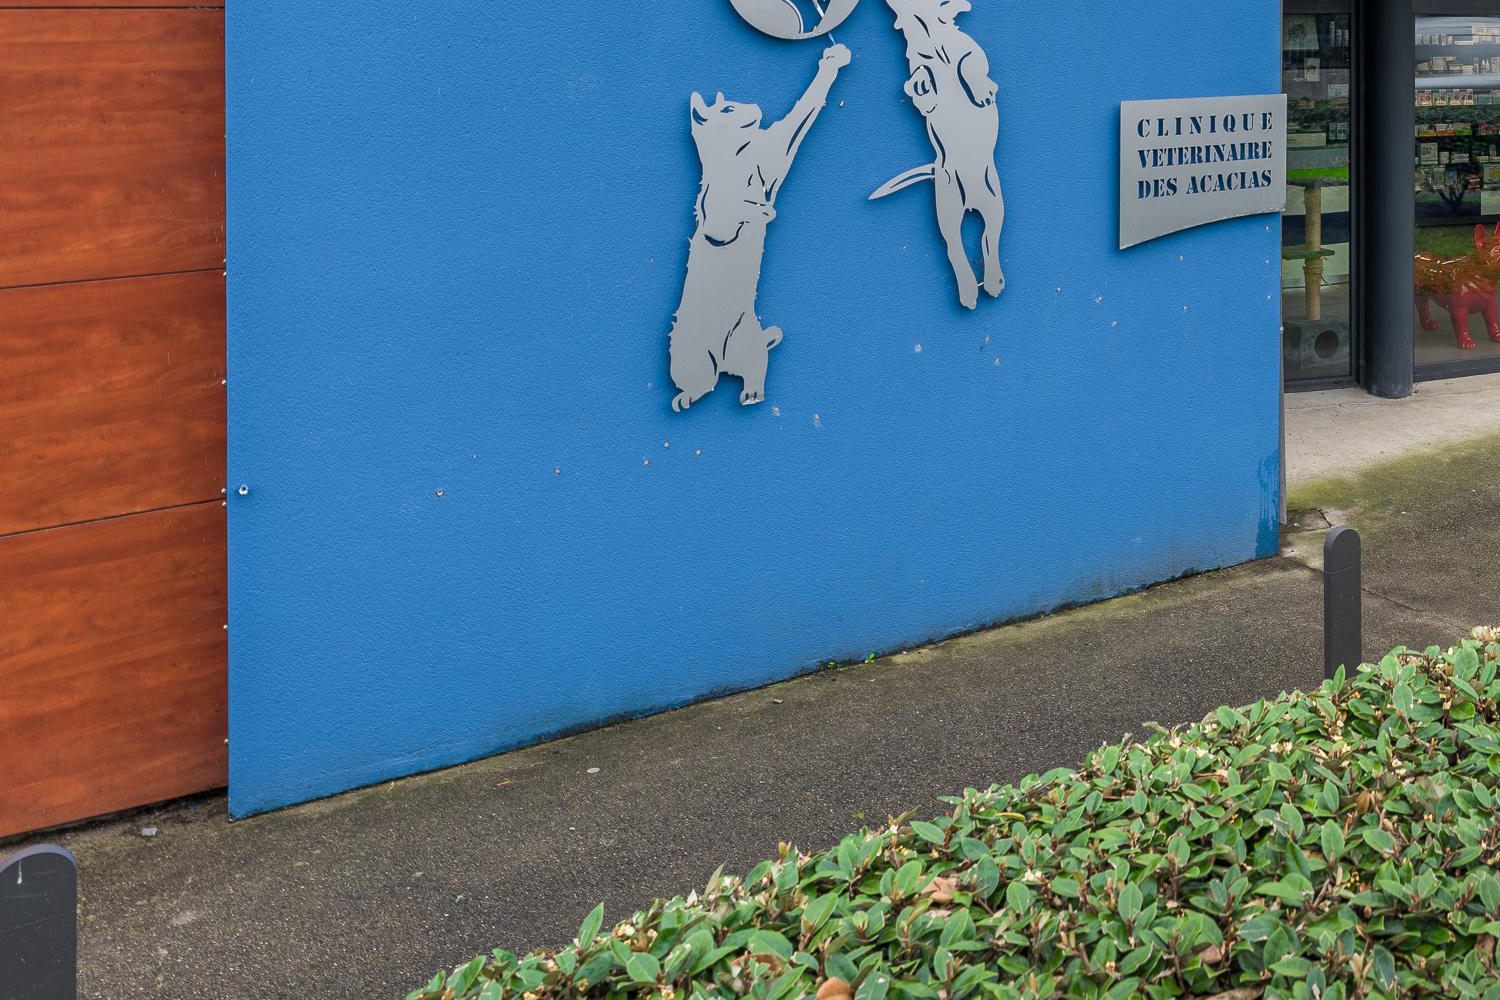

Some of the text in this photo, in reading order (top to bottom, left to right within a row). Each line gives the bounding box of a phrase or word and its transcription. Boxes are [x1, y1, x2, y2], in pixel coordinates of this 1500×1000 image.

[1137, 112, 1272, 138] CLINIQUE
[1138, 141, 1272, 168] VETERINAIRE
[1137, 169, 1272, 199] DES ACACIAS
